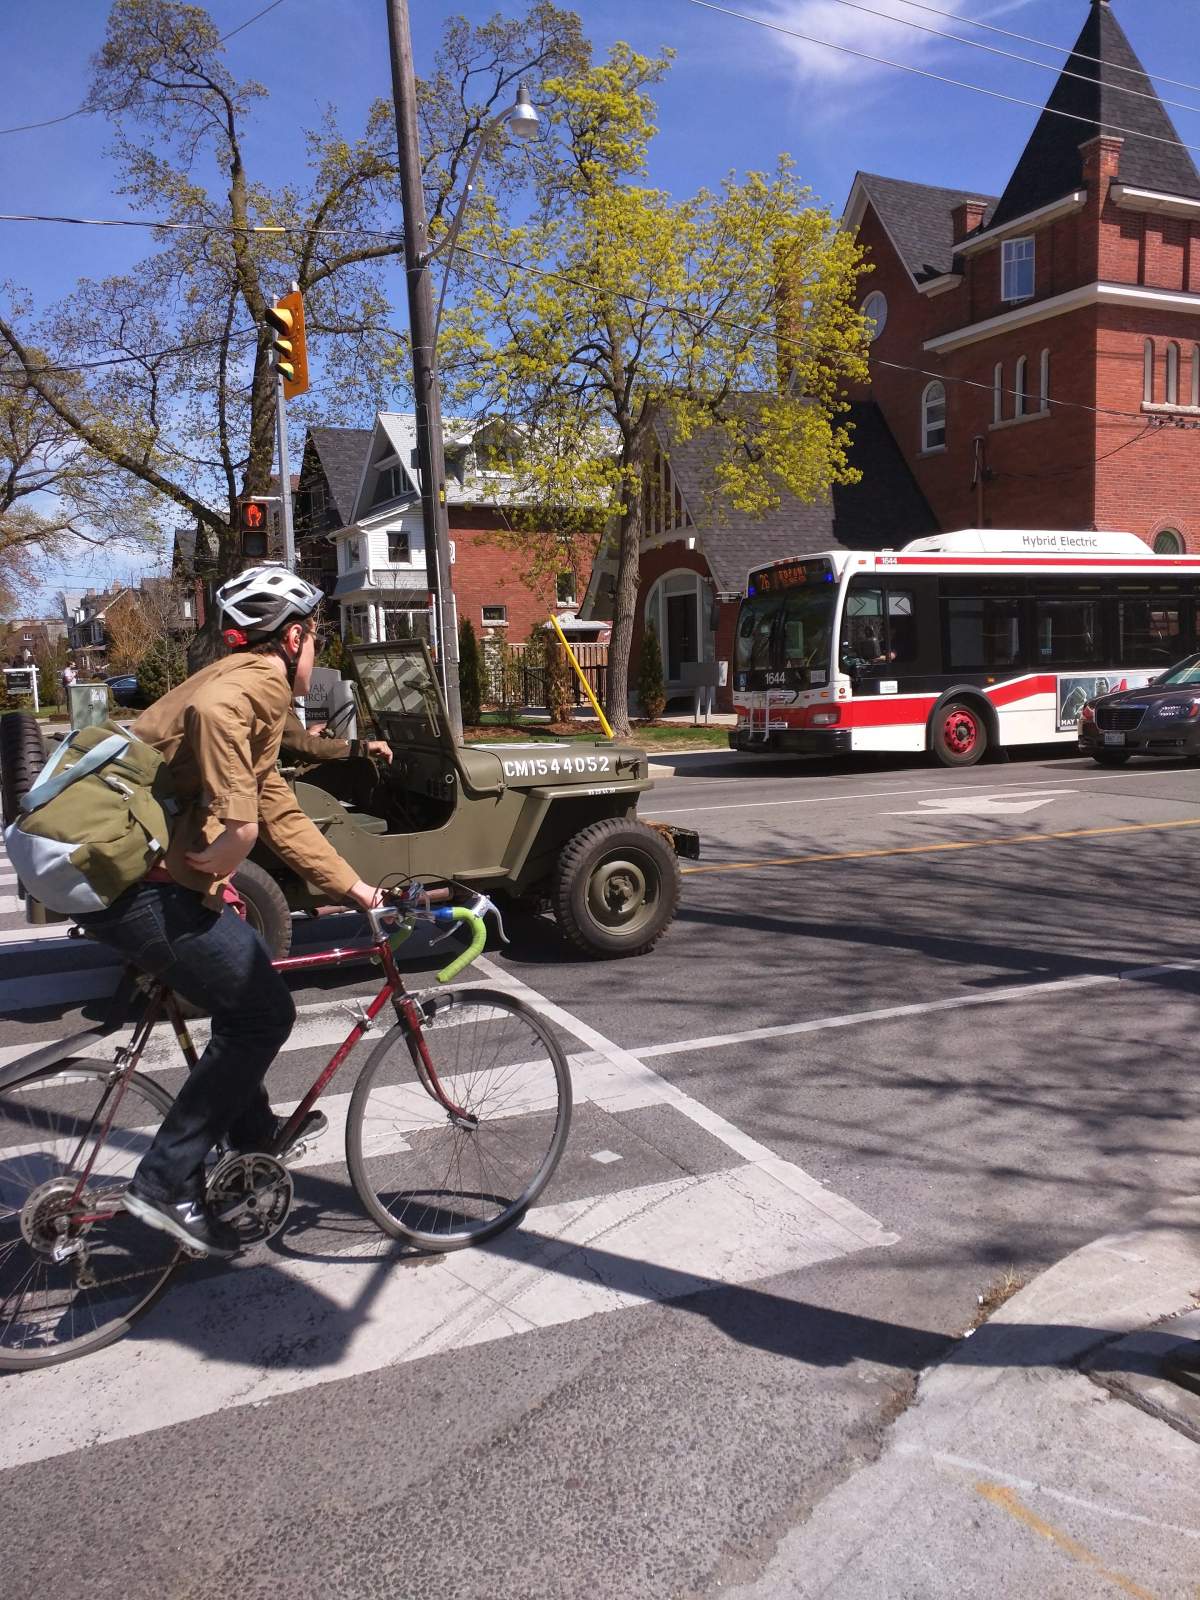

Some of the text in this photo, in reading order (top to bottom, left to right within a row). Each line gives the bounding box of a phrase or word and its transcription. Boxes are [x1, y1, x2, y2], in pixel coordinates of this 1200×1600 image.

[1022, 535, 1098, 548] Hybrid Electric
[765, 671, 786, 685] 1644
[504, 756, 610, 778] CM1544052
